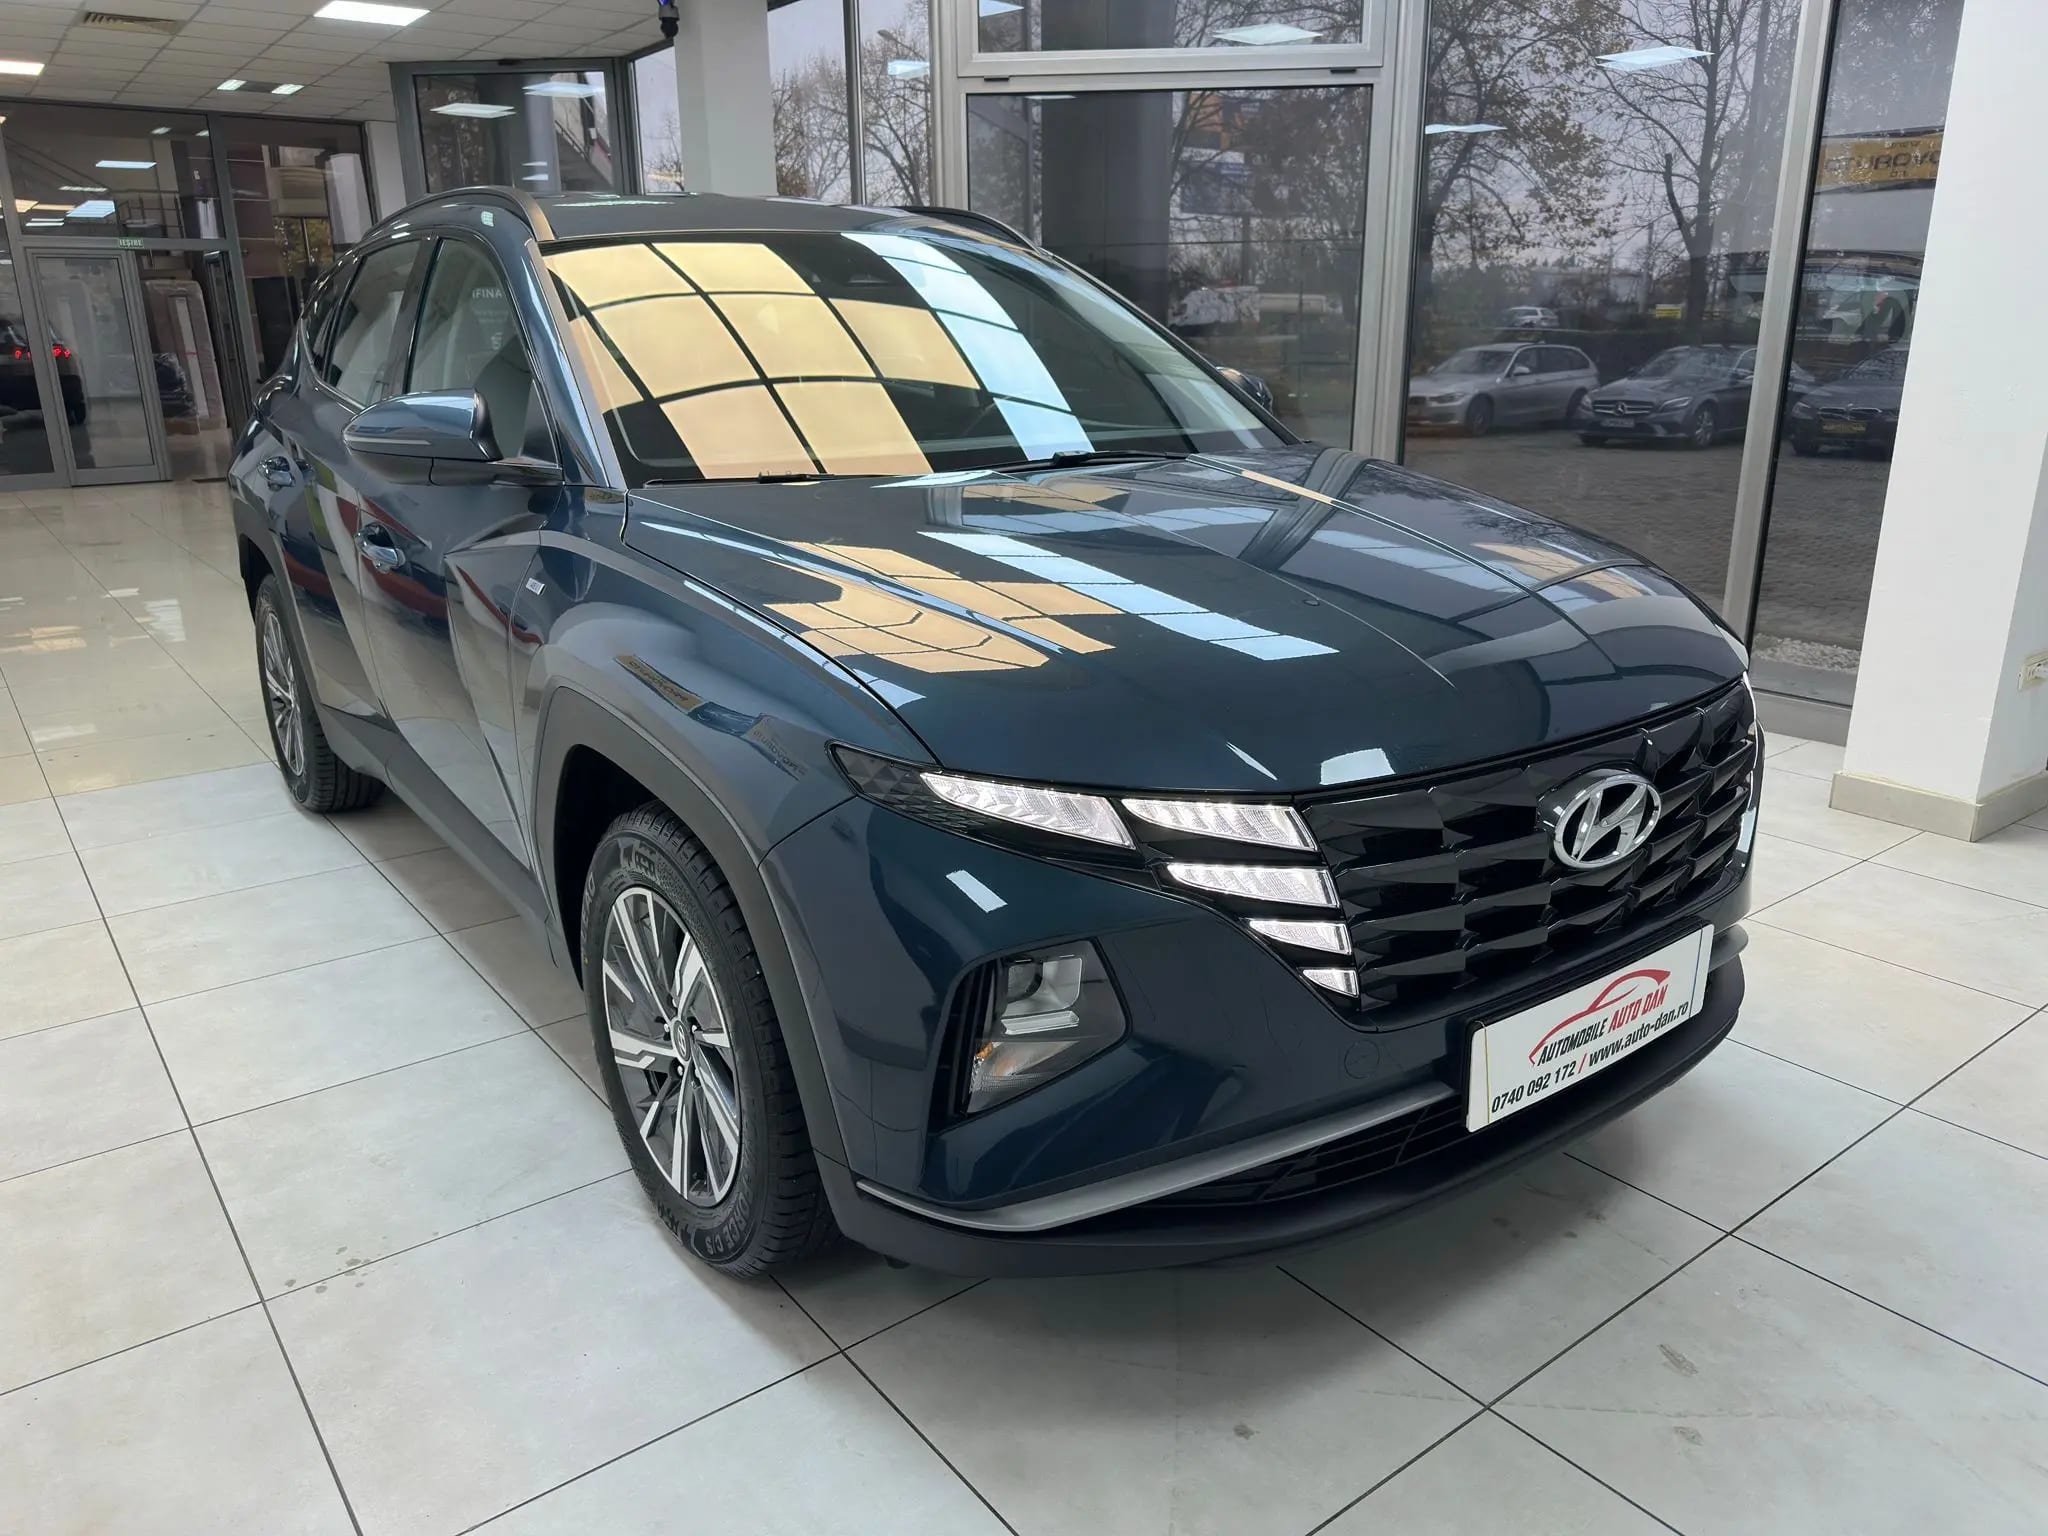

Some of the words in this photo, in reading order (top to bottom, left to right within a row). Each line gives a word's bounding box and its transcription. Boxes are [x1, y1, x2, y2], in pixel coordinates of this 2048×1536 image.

[1491, 1085, 1524, 1113] 0740
[1527, 1072, 1551, 1096] 092
[1555, 1061, 1577, 1083] 172
[1589, 1001, 1689, 1067] www.auto-dan.ro
[1537, 1018, 1608, 1066] AUTOMOBILE
[1608, 998, 1642, 1034] AUTO
[1641, 984, 1668, 1016] DAN
